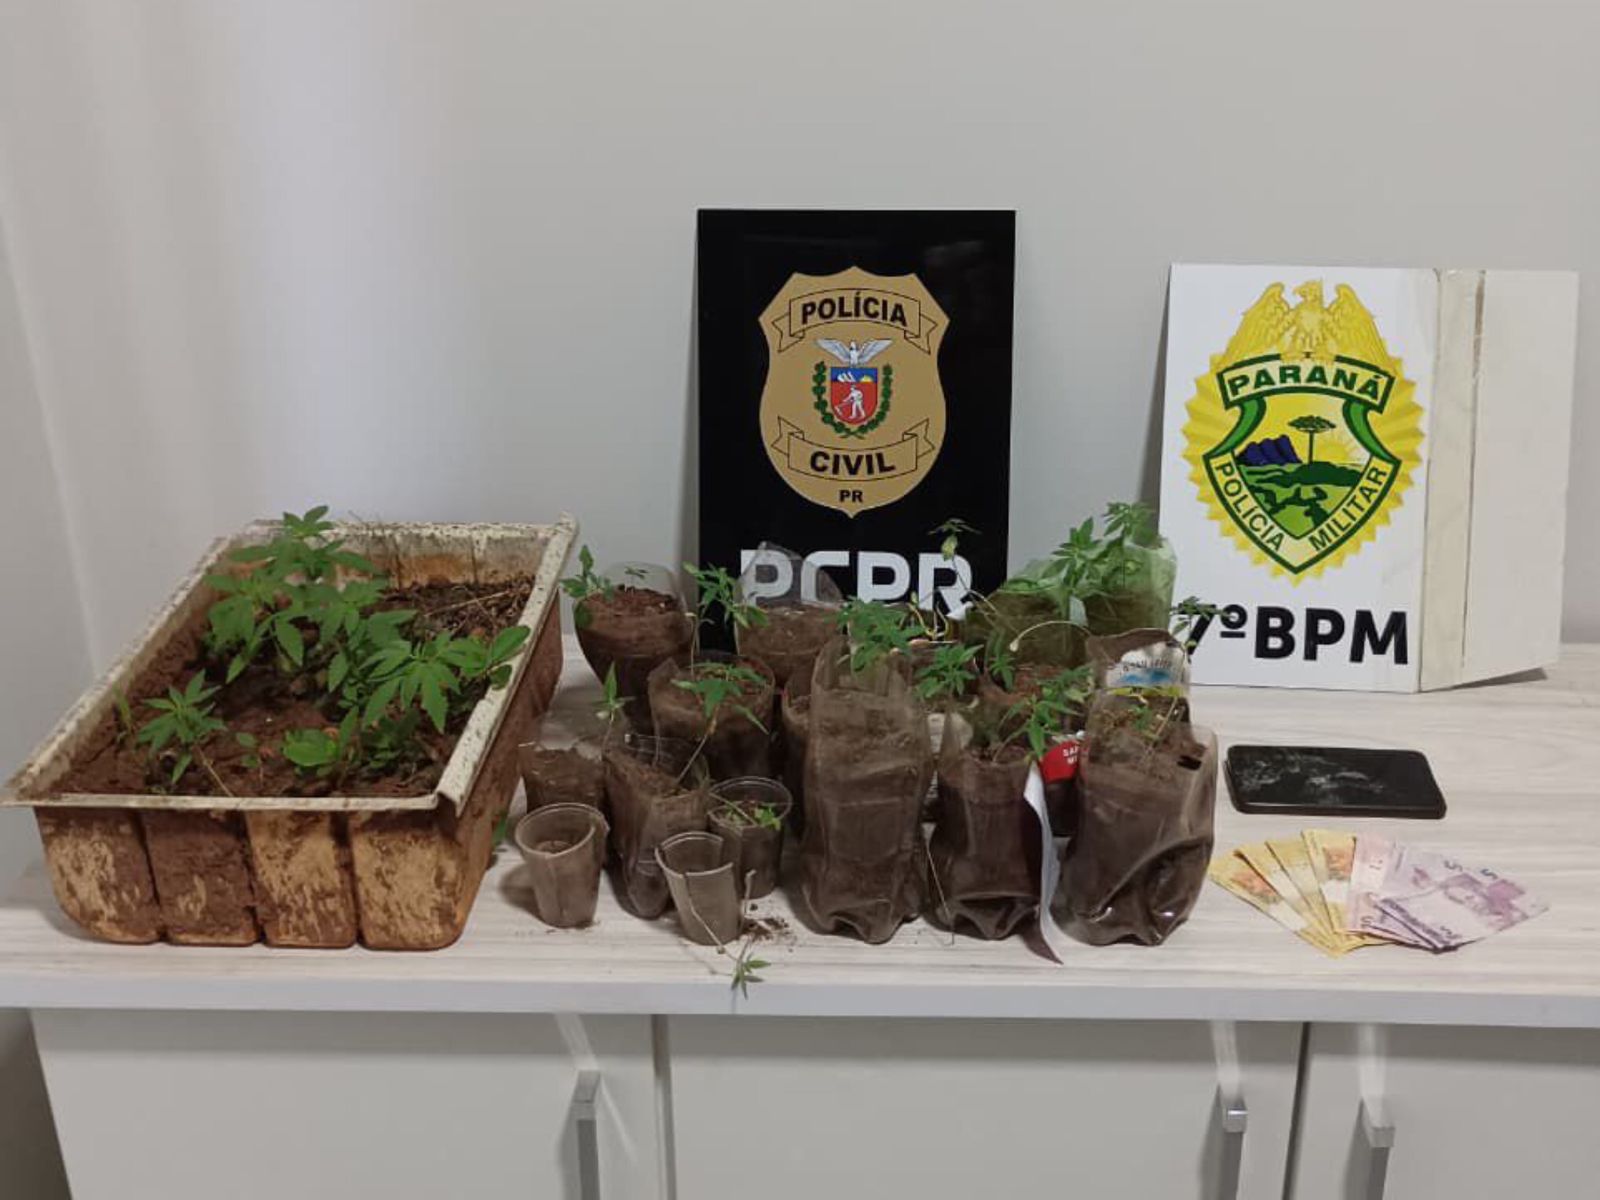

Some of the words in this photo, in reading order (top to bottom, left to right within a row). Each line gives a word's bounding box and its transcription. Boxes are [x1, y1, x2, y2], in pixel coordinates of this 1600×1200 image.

[801, 291, 907, 327] POLÍCIA
[1228, 365, 1380, 401] PARANÁ
[810, 451, 896, 475] CIVIL
[839, 489, 863, 502] PR
[1216, 462, 1285, 551] POLÍCIA
[1308, 466, 1387, 551] MILITAR
[740, 549, 973, 617] PCPR
